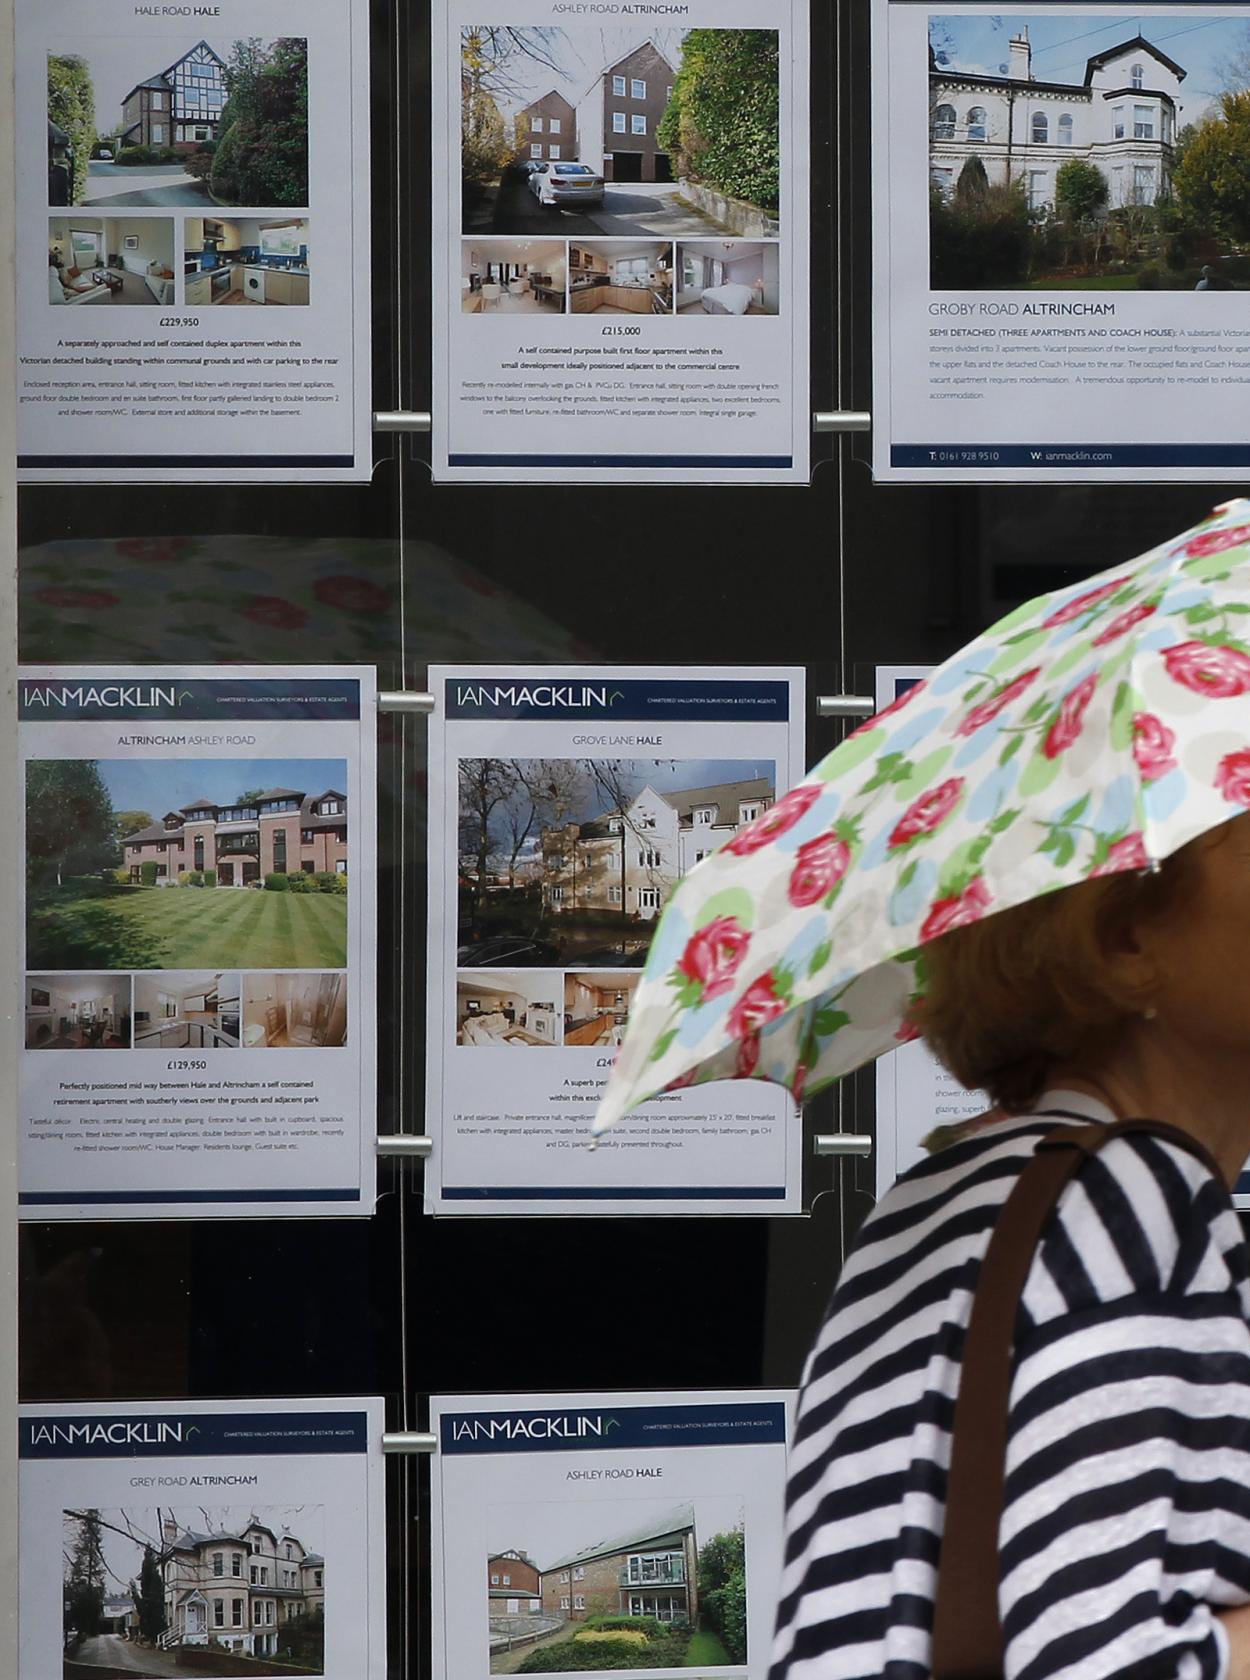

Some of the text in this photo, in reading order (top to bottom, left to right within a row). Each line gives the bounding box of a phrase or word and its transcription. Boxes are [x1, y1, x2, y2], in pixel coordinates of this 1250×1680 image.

[134, 6, 220, 16] HALE ROAD HALE
[552, 4, 688, 14] ASHLEY ROAD ALTRINCHAM
[928, 303, 1115, 315] GROBY ROAD ALTRINCHAM
[159, 318, 199, 327] £229,950
[601, 326, 641, 336] £215,000
[929, 329, 948, 337] SEMI
[950, 329, 996, 337] DETACHED
[998, 329, 1028, 338] (THREE
[1030, 329, 1086, 337] APARTMENTS
[1087, 329, 1107, 337] AND
[1109, 329, 1141, 337] COACH
[939, 452, 958, 460] 0161
[961, 452, 977, 460] 928
[978, 452, 999, 460] 9510
[1045, 451, 1112, 460] ianmacklin.com
[117, 736, 256, 745] ALTRINCHAM ASHLEY ROAD
[572, 736, 662, 745] GROVE LANE HALE
[167, 1060, 207, 1070] £129,950
[566, 1468, 663, 1480] ASHLEY ROAD HALE
[129, 1475, 258, 1487] GREY ROAD ALTRINCHAM
